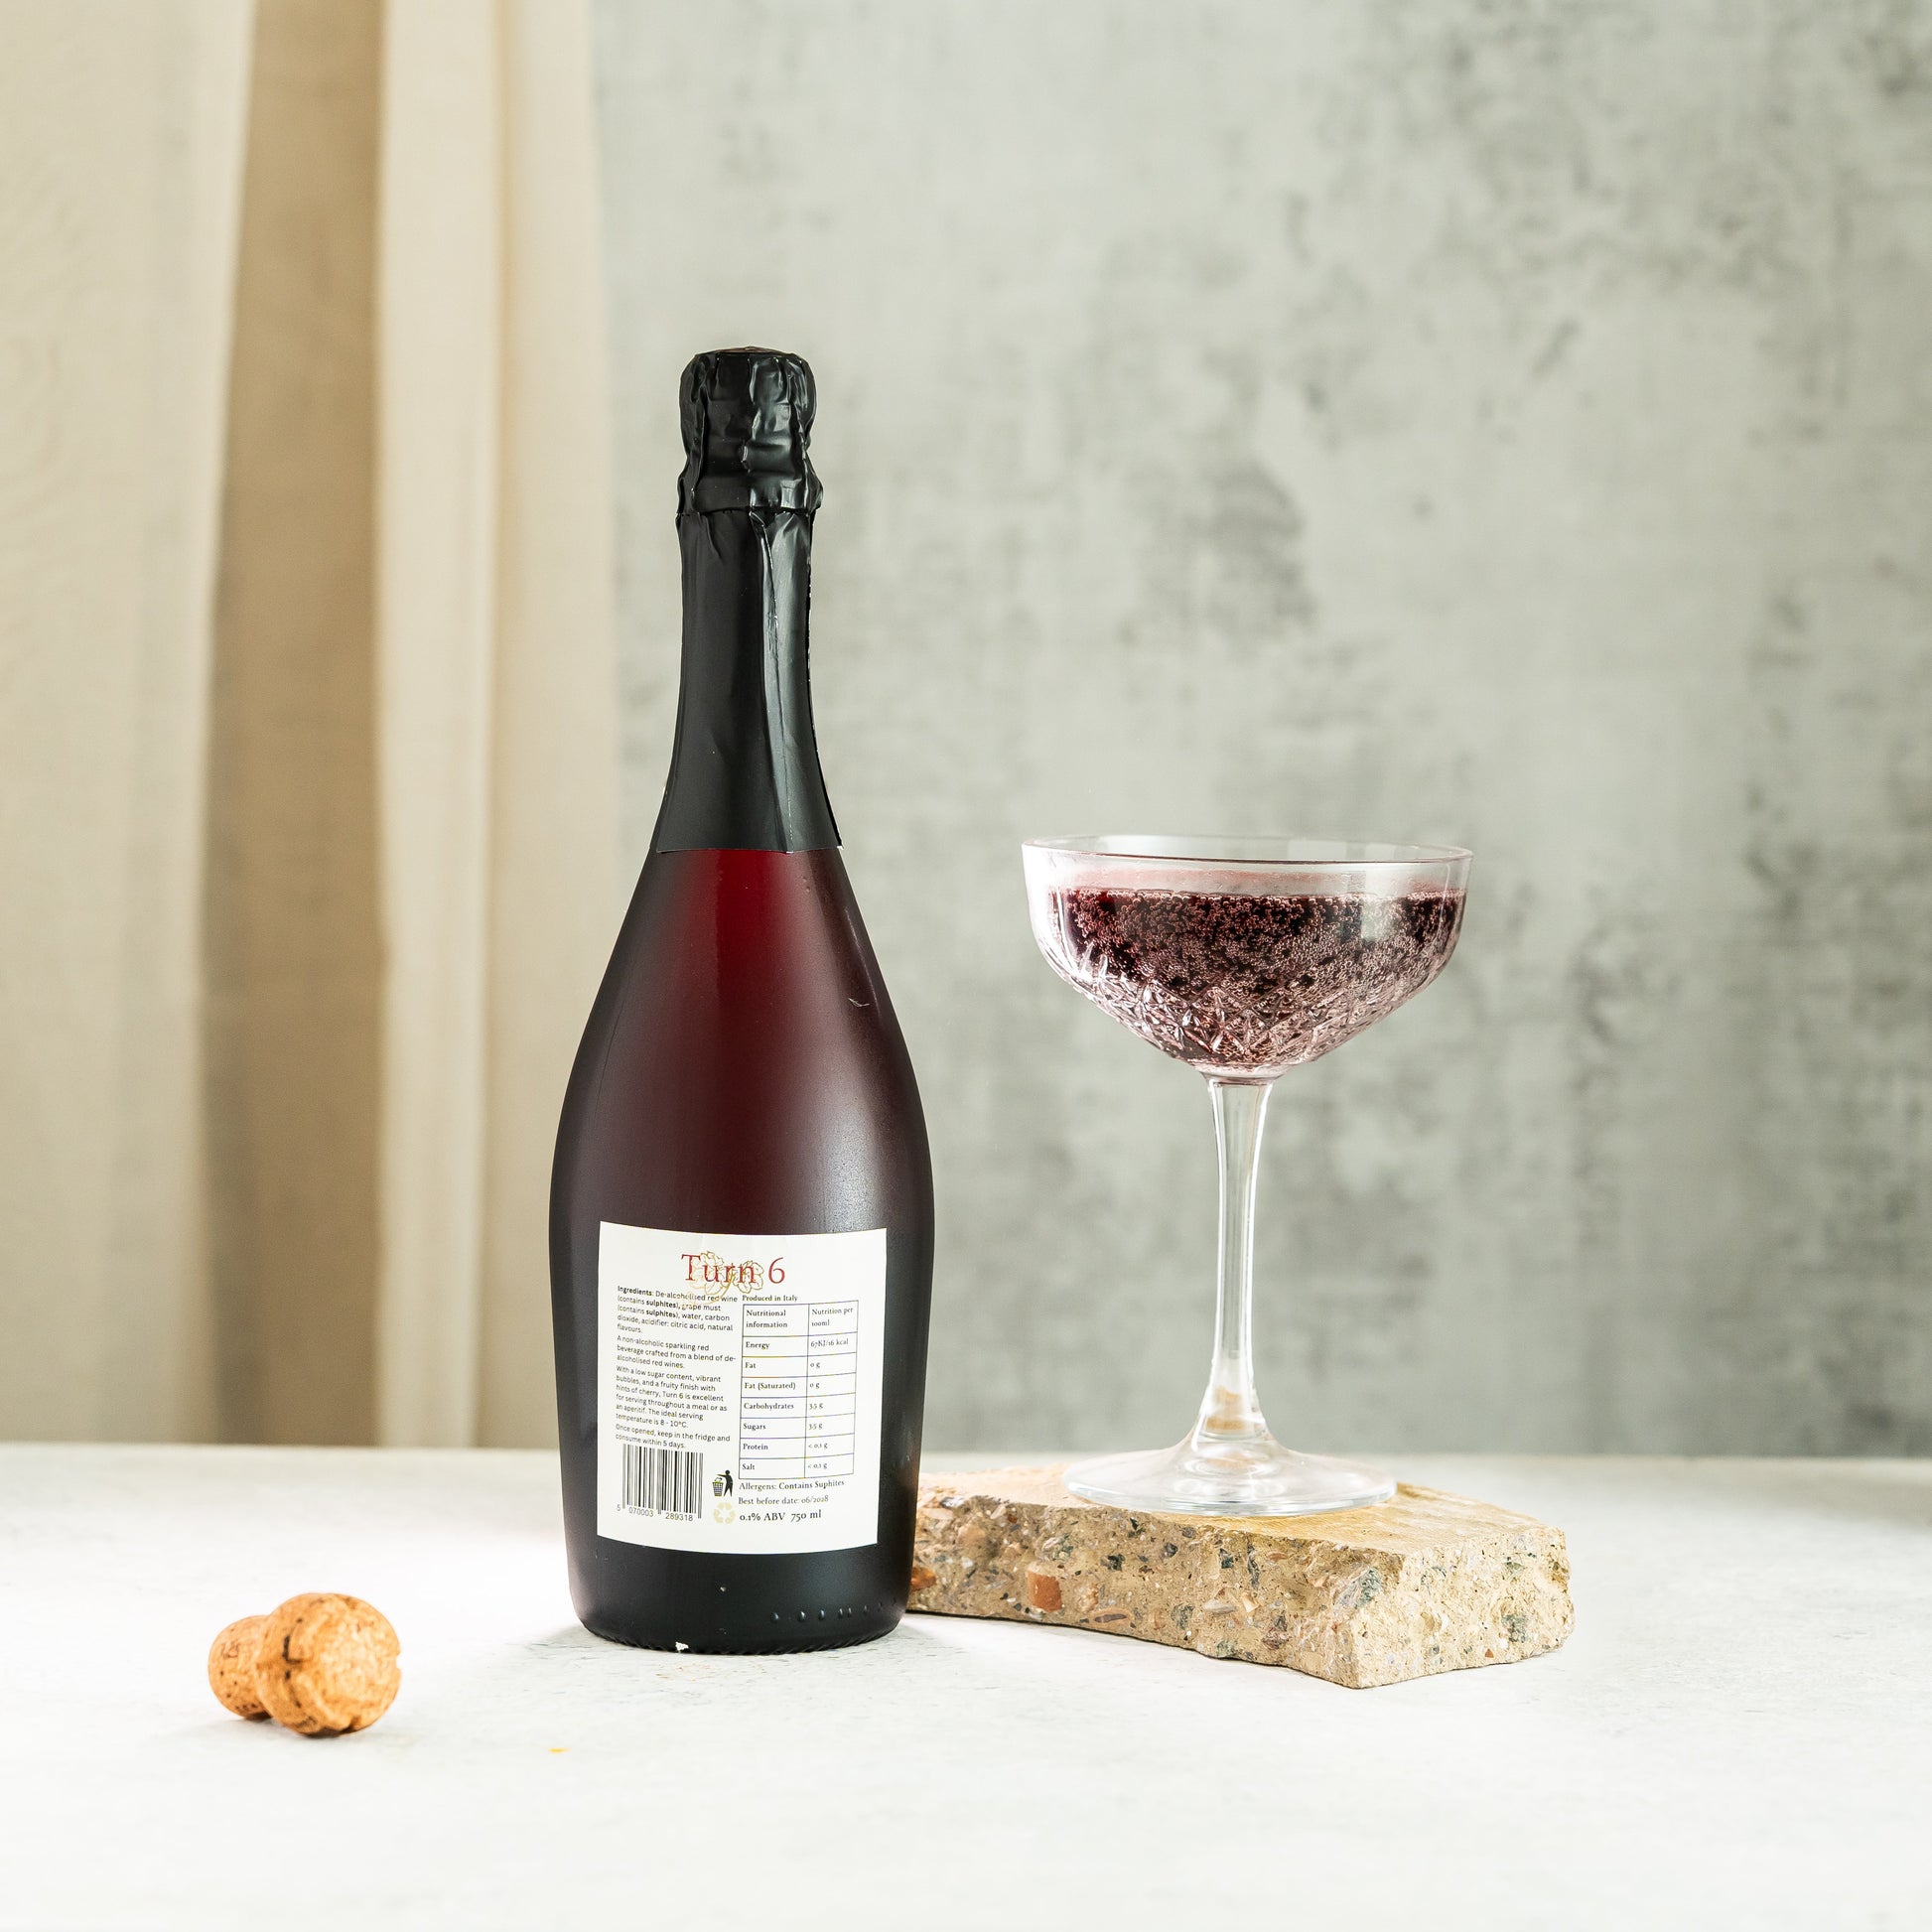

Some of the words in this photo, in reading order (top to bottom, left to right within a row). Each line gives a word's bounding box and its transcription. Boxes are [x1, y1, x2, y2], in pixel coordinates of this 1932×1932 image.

[681, 1254, 757, 1283] Turn
[768, 1257, 785, 1284] 6
[617, 1285, 654, 1296] Ingredients:
[617, 1295, 645, 1305] (contains
[646, 1300, 680, 1309] sulphites),
[617, 1304, 645, 1314] (contains
[646, 1310, 680, 1319] sulphites),
[617, 1314, 640, 1324] dioxide,
[641, 1318, 669, 1327] acidifier:
[617, 1324, 643, 1333] flavours.
[622, 1337, 664, 1347] non-alcoholic
[665, 1343, 695, 1351] sparkling
[617, 1345, 644, 1355] beverage
[617, 1354, 650, 1365] alcoholised
[616, 1375, 641, 1385] bubbles,
[661, 1381, 678, 1390] fruity
[666, 1373, 694, 1381] content,
[758, 1382, 796, 1390] (Saturated)
[639, 1388, 661, 1397] cherry,
[625, 1397, 647, 1405] serving
[648, 1399, 685, 1408] throughout
[616, 1413, 653, 1424] temperature
[624, 1405, 647, 1414] aperitif.
[679, 1412, 703, 1421] serving
[615, 1433, 641, 1442] consume
[616, 1423, 630, 1432] Once
[631, 1427, 656, 1436] opened,
[695, 1433, 715, 1441] fridge
[739, 1483, 776, 1491] Allergens:
[815, 1480, 844, 1489] Suphites
[801, 1495, 829, 1504] 06/2028
[629, 1507, 653, 1517] 070003
[666, 1512, 693, 1521] 289318
[739, 1513, 761, 1521] 0.1%
[764, 1512, 786, 1521] ABV
[791, 1513, 807, 1522] 750
[810, 1509, 821, 1518] ml
